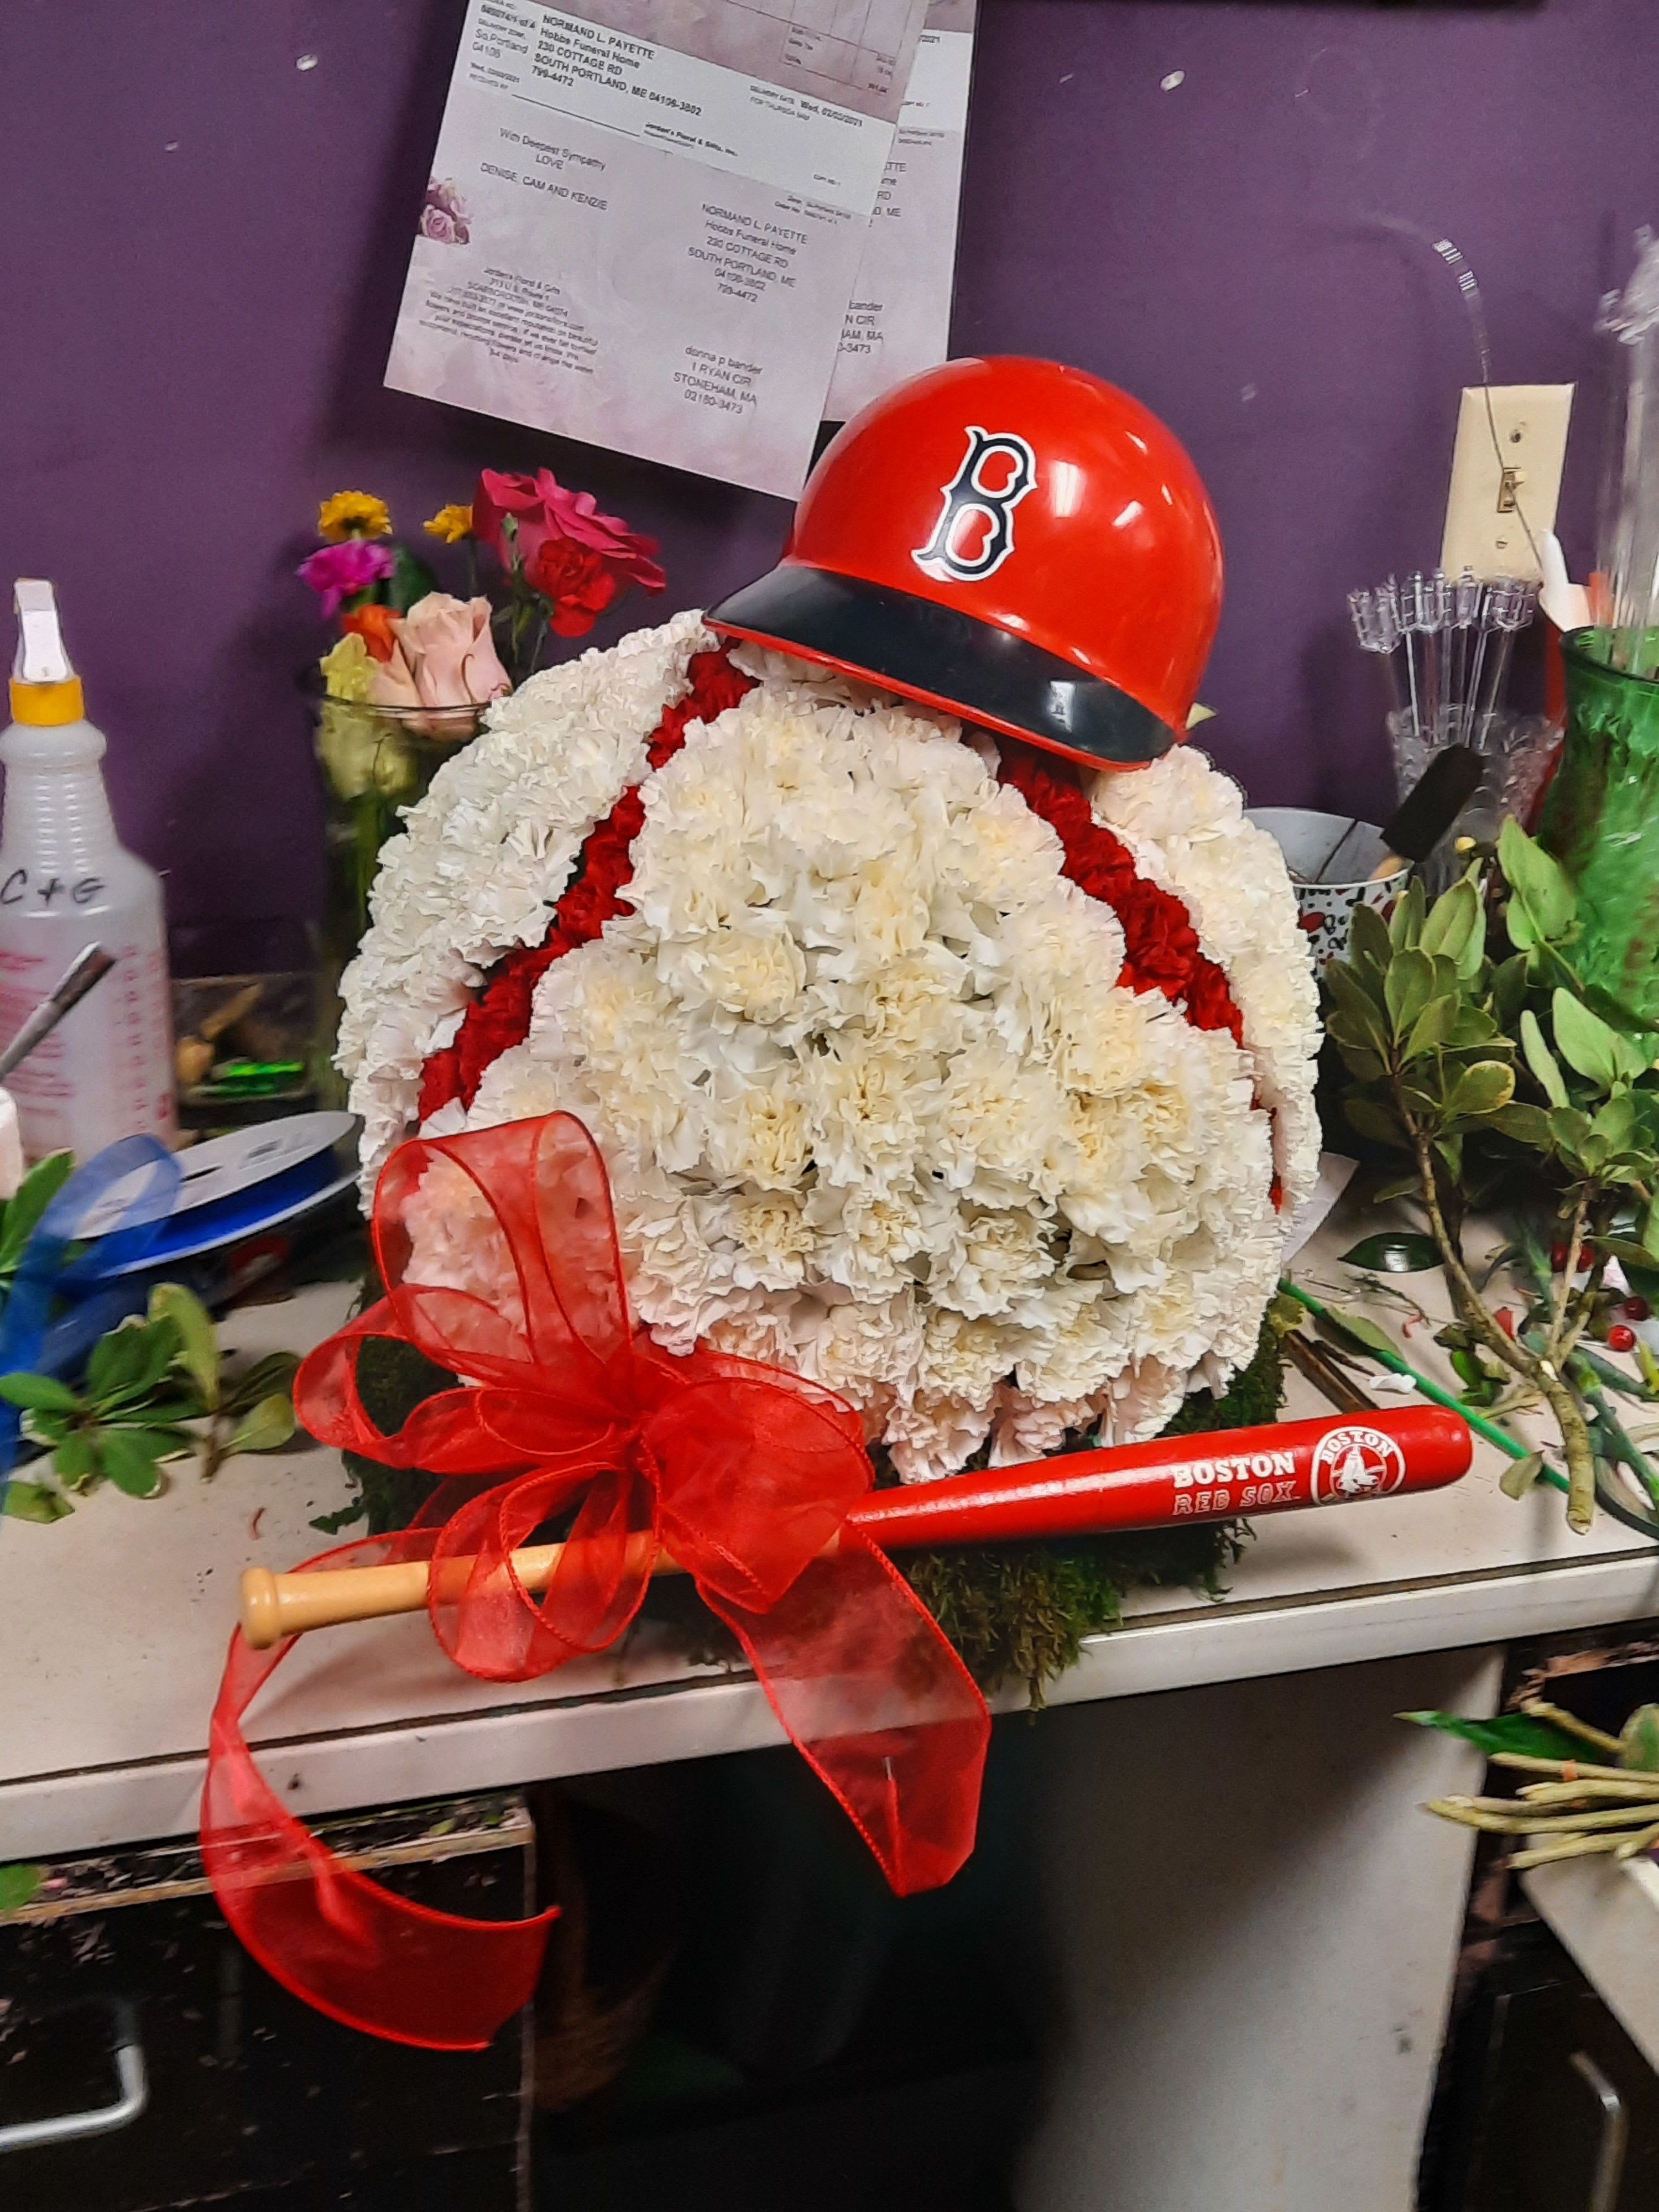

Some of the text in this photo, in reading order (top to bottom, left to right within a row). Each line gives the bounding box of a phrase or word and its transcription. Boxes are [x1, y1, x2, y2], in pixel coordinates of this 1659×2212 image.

[542, 14, 594, 39] NORMAND
[608, 36, 655, 60] PAYETTE
[557, 47, 605, 70] COTTAGE
[607, 64, 623, 75] RD
[573, 39, 611, 58] Funeral
[612, 51, 640, 69] Home
[534, 53, 569, 72] SOUTH
[631, 85, 648, 98] ME
[535, 154, 564, 170] LOVE
[547, 184, 569, 197] AND
[702, 204, 752, 226] NORMAND
[764, 222, 807, 245] PAYETTE
[735, 229, 769, 247] Funeral
[688, 247, 722, 264] SOUTH
[726, 242, 771, 264] COTTAGE
[773, 256, 789, 268] RD
[685, 345, 717, 362] donna
[699, 363, 731, 381] RYAN
[732, 374, 752, 387] CIR
[911, 425, 1039, 582] B
[1318, 1430, 1396, 1465] BOSTON
[1171, 1451, 1296, 1489] BOSTON
[1172, 1480, 1301, 1516] RED SOX
